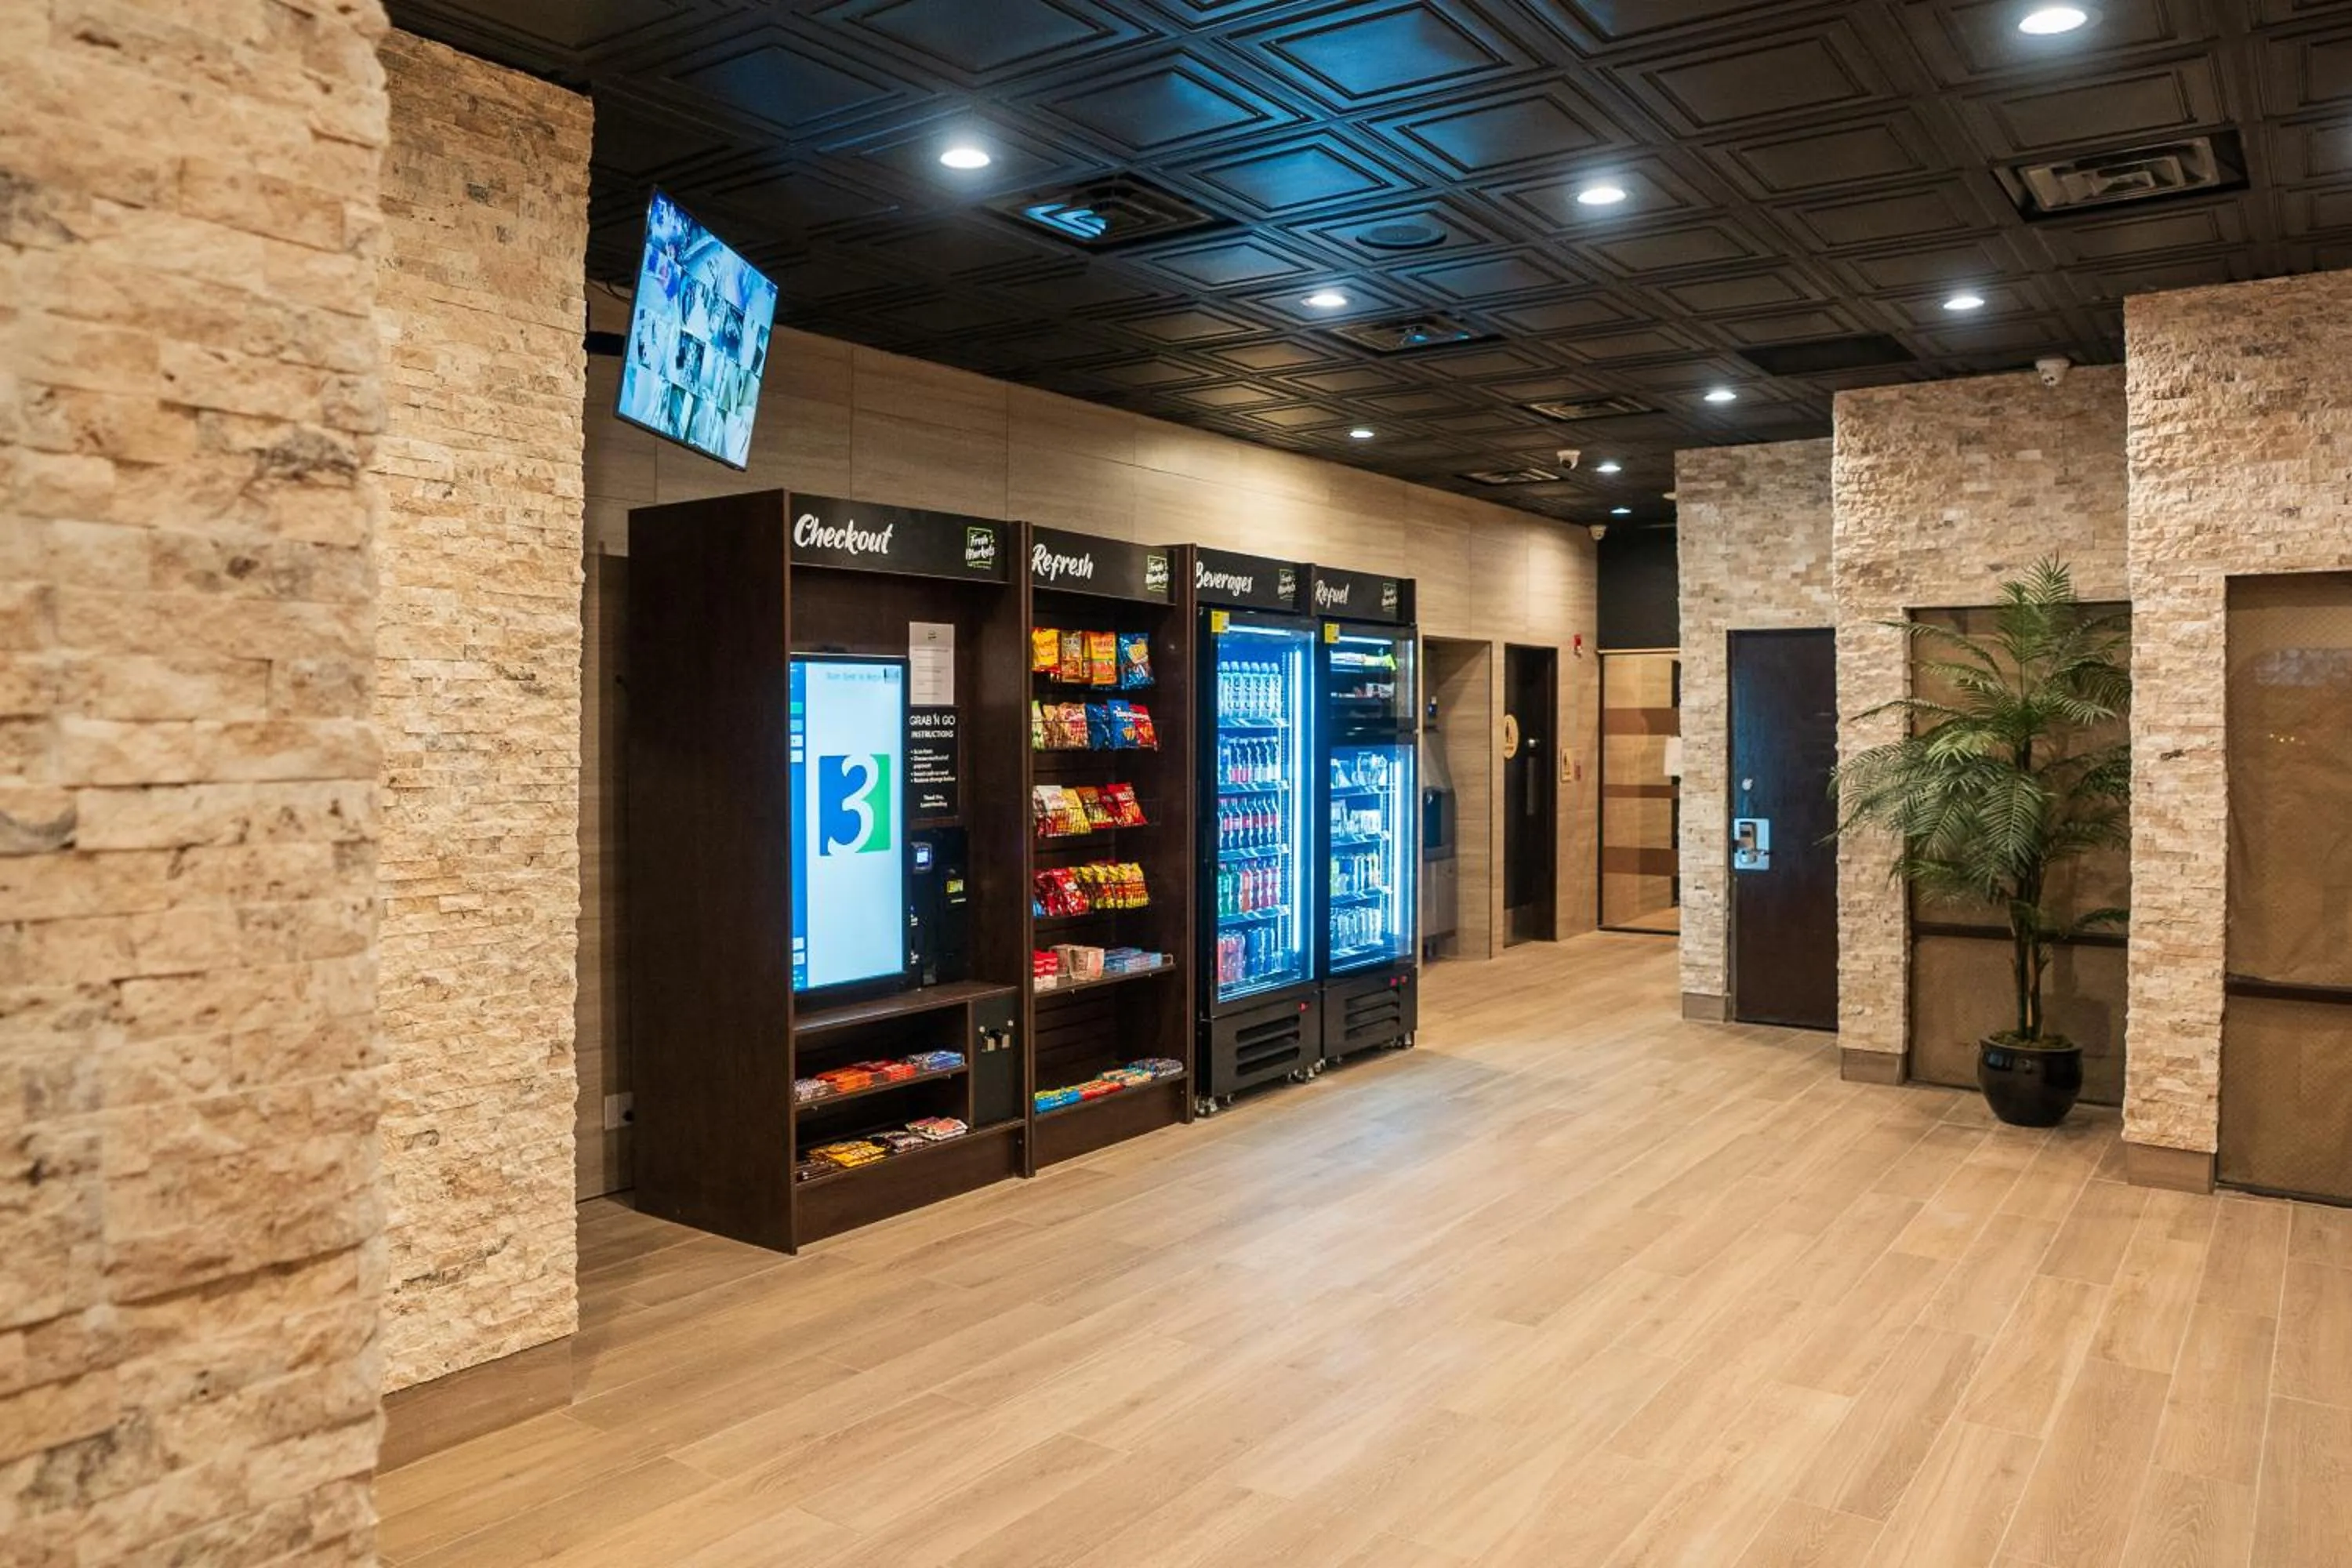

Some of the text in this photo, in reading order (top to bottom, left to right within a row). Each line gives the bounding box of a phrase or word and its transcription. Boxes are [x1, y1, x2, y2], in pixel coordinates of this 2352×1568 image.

[793, 513, 894, 555] Checkout
[1031, 543, 1094, 582] Refresh
[1195, 561, 1254, 597] Beverages
[1315, 579, 1350, 608] Refuel
[909, 714, 932, 726] GRAB
[942, 714, 956, 726] GO
[910, 730, 954, 739] INSTRUCTIONS
[827, 753, 879, 857] 3
